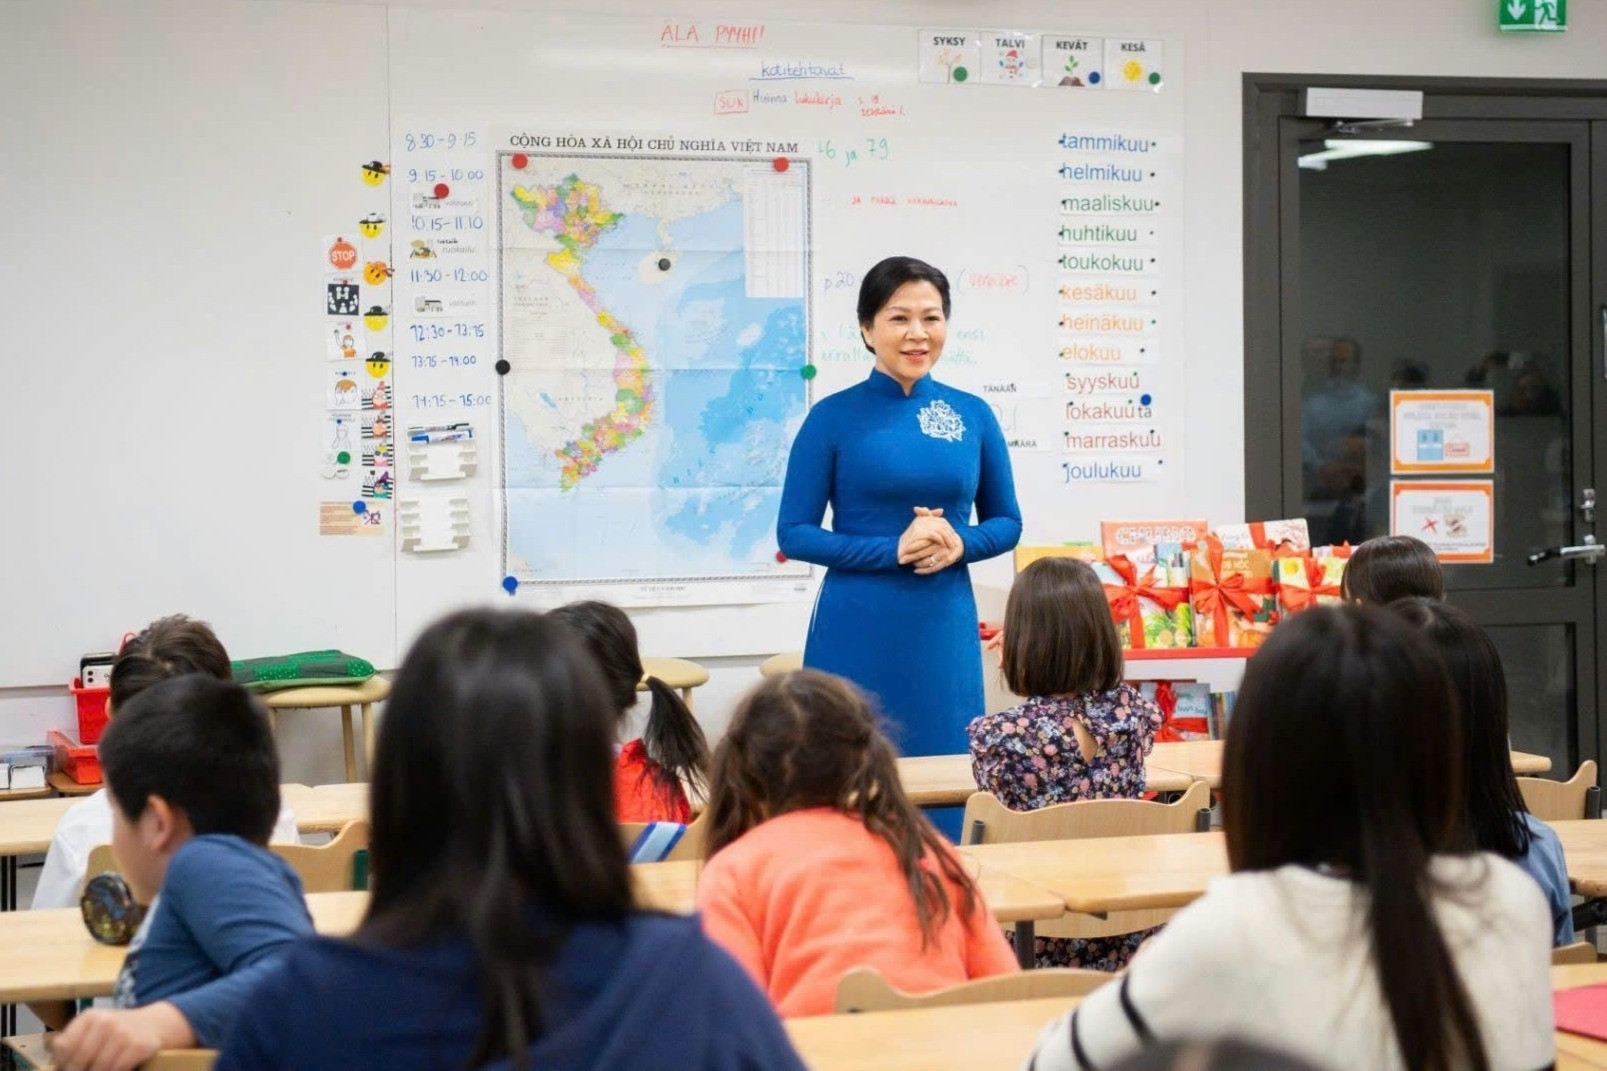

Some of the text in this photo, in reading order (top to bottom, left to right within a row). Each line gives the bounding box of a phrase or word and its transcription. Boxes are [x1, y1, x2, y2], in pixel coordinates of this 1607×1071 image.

[933, 36, 966, 46] SYKSY
[996, 38, 1025, 49] TALVI
[1056, 40, 1088, 51] KEVÄT
[1121, 42, 1146, 52] KESÄ
[510, 132, 798, 154] CỘNG HÒA XÃ HỘI CHỦ NGHĨA VIỆT NAM
[1062, 132, 1149, 152] tammikuu
[1062, 162, 1143, 182] helmikuu
[1063, 194, 1154, 211] maaliskuu
[1062, 225, 1137, 242] huhtikuu
[331, 250, 355, 263] STOP
[1062, 253, 1143, 271] toukokuu
[1062, 283, 1137, 301] kesäkuu
[1062, 313, 1144, 332] heinäkuu
[1063, 344, 1121, 361] elokuu
[1066, 373, 1140, 394] syyskuu
[1066, 431, 1161, 450] marraskuu
[1065, 462, 1142, 483] joulukuu
